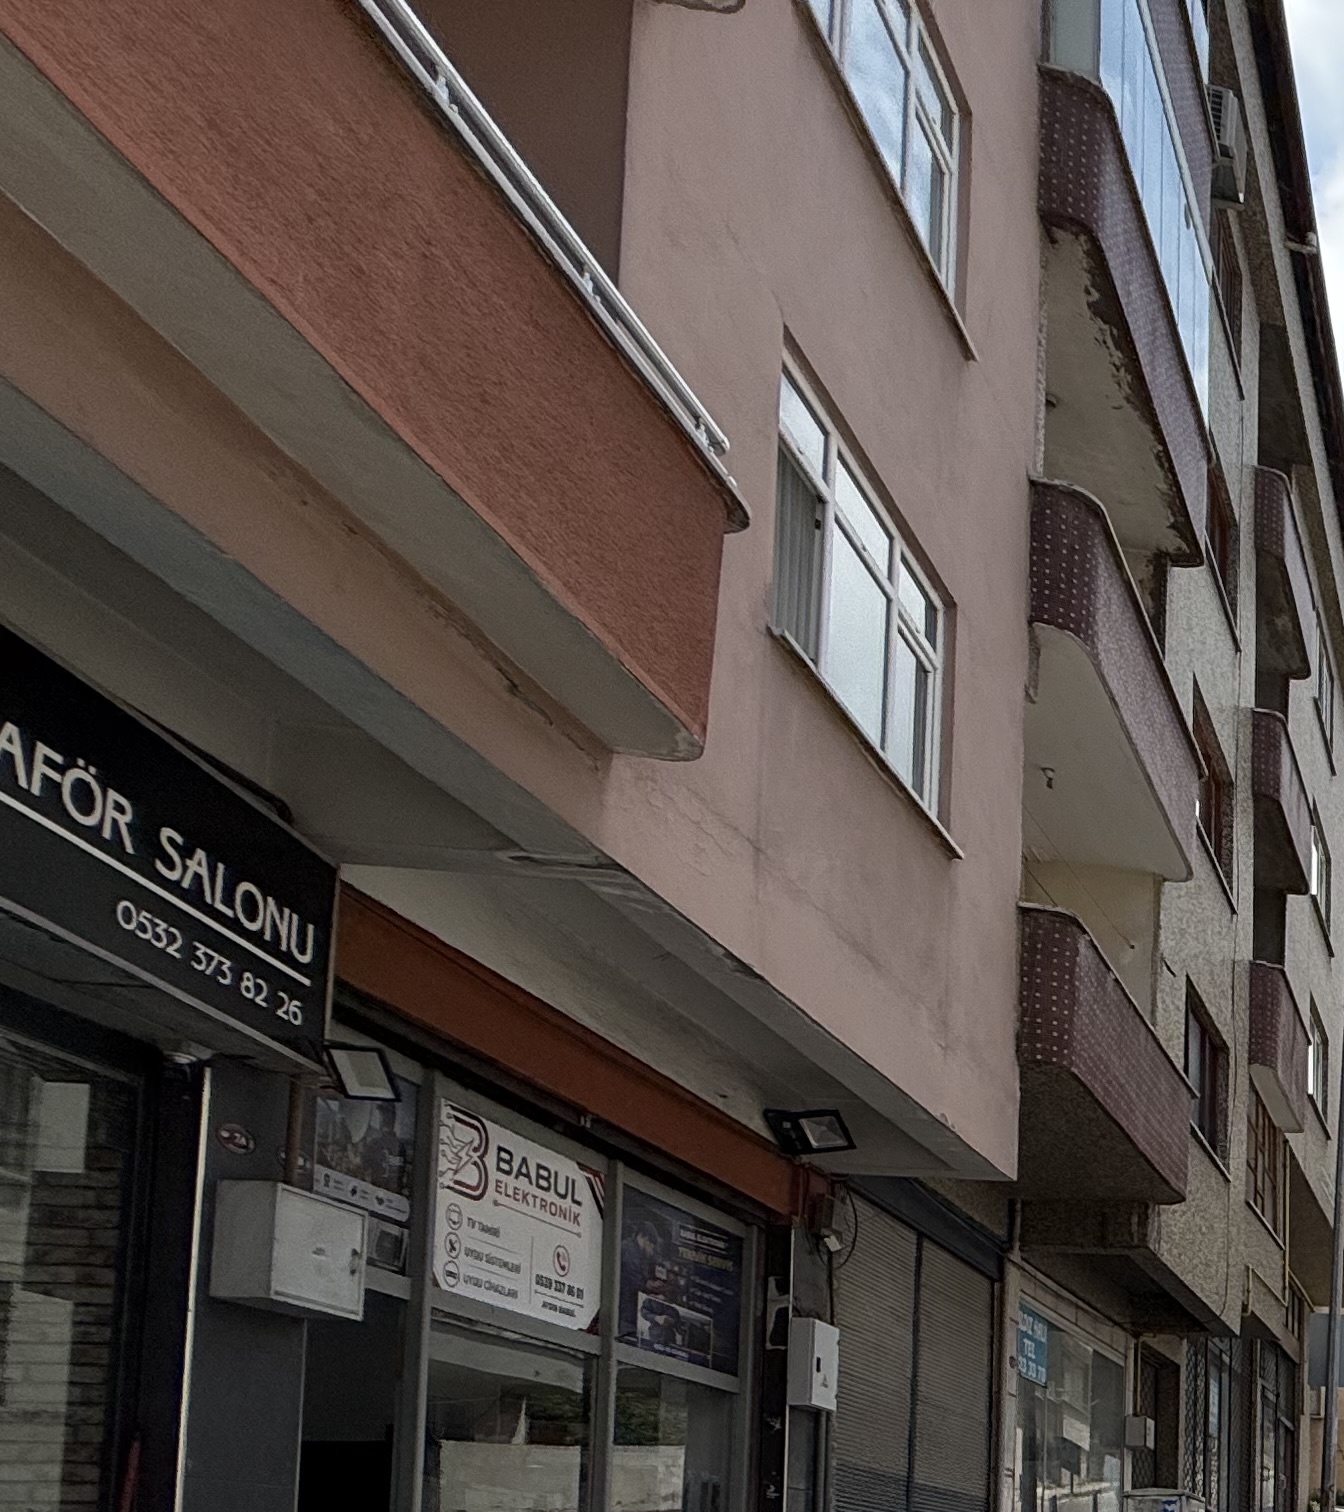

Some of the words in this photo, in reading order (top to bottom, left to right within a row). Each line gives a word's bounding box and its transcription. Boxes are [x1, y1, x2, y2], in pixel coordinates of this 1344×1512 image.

[0, 721, 135, 854] AFÖR
[155, 827, 314, 964] SALONU
[116, 900, 183, 959] 0532
[190, 940, 233, 985] 373
[240, 971, 268, 1008] 82
[276, 990, 303, 1026] 26
[495, 1179, 582, 1228] ELEKTRONİK
[496, 1145, 583, 1208] BABUL
[467, 1216, 477, 1229] TV
